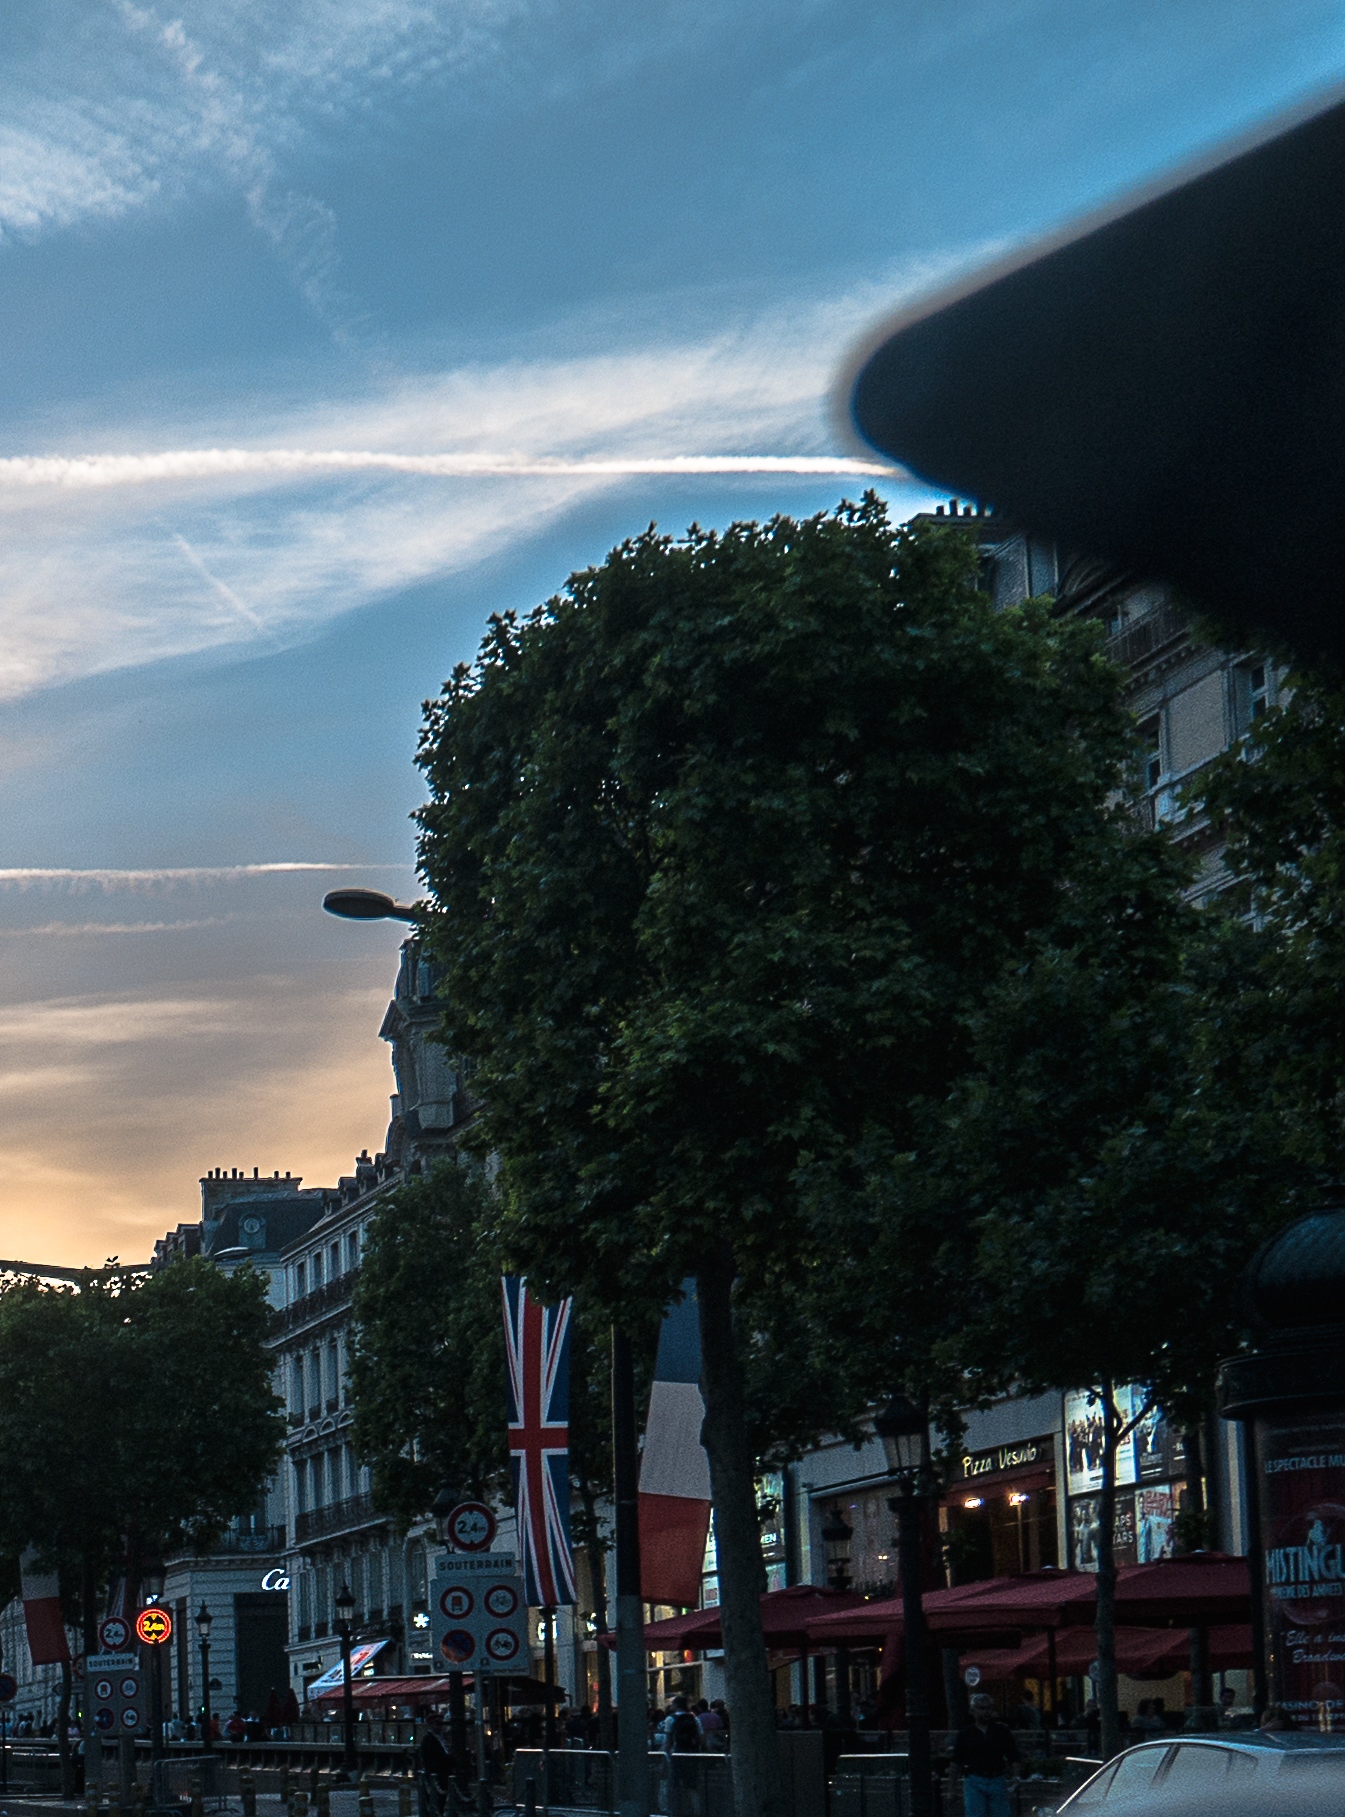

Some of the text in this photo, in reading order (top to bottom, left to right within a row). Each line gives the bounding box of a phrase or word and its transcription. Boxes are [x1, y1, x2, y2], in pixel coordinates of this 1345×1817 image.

[961, 1442, 1038, 1479] Pizza Vesuvio
[1273, 1455, 1326, 1473] SPECTACLE
[439, 1560, 513, 1572] SOUTERRAIN
[261, 1568, 291, 1591] Ca
[88, 1658, 134, 1668] SOUTERRAIN
